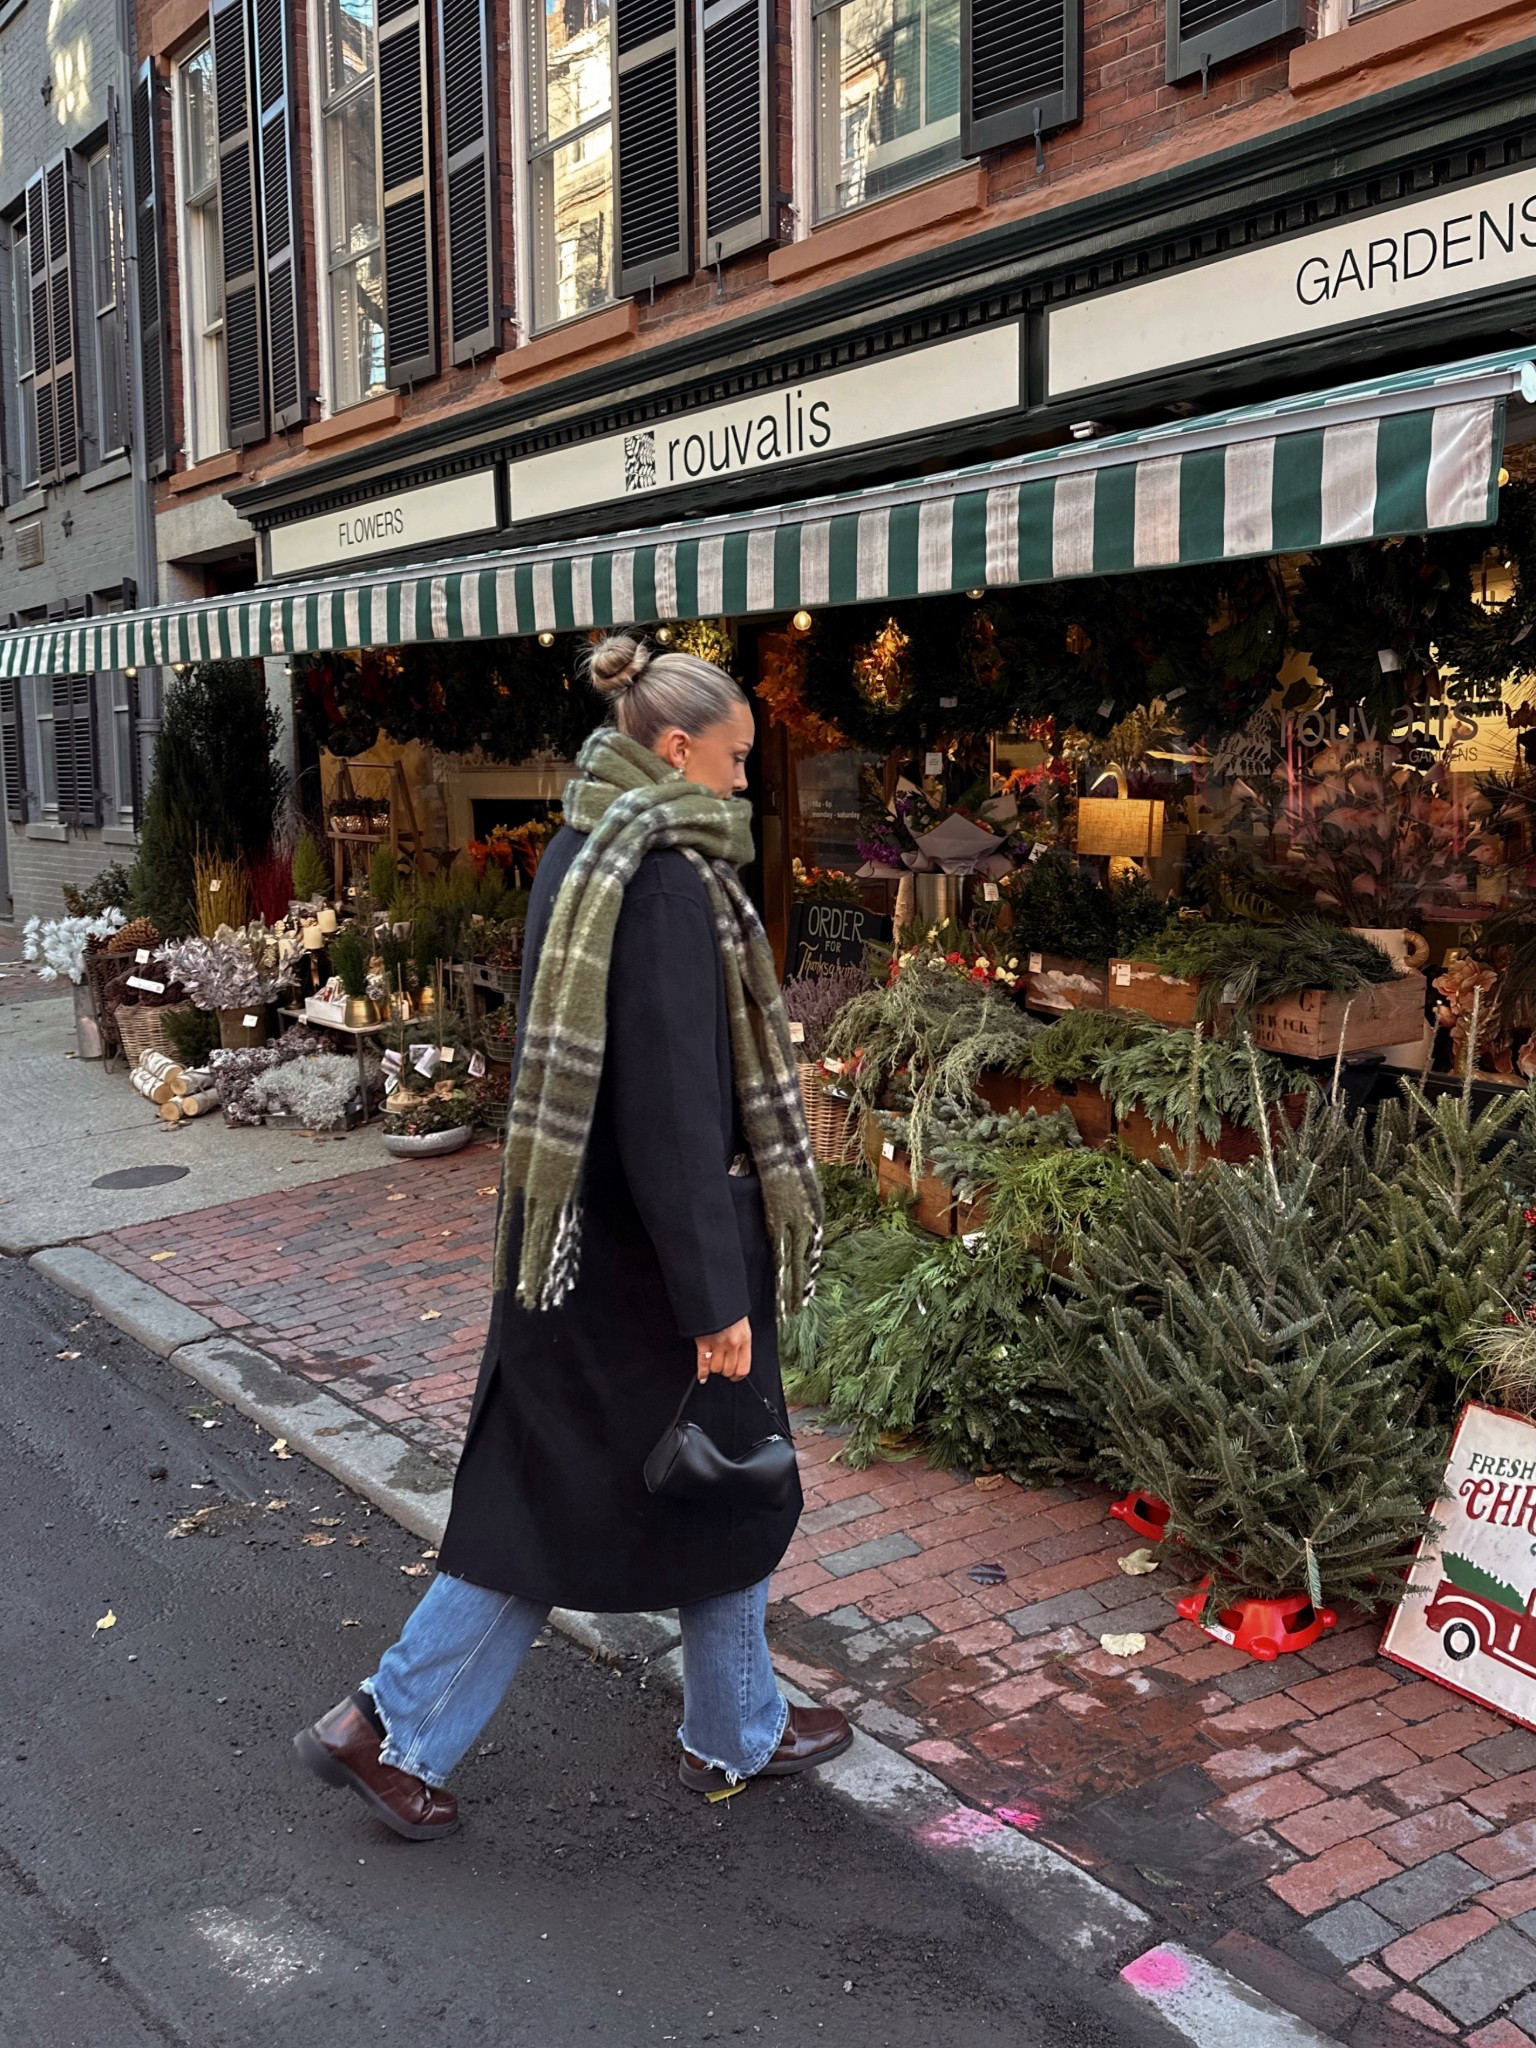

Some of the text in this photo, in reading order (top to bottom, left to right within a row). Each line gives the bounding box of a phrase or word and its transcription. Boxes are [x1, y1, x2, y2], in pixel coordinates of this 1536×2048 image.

[668, 390, 832, 482] rouvalis
[338, 508, 404, 547] FLOWERS
[1408, 747, 1478, 763] GARDENS
[812, 811, 833, 820] monday
[837, 811, 861, 821] saturday
[808, 906, 865, 943] ORDER
[825, 940, 842, 953] FOR
[1467, 1453, 1536, 1480] FRESH
